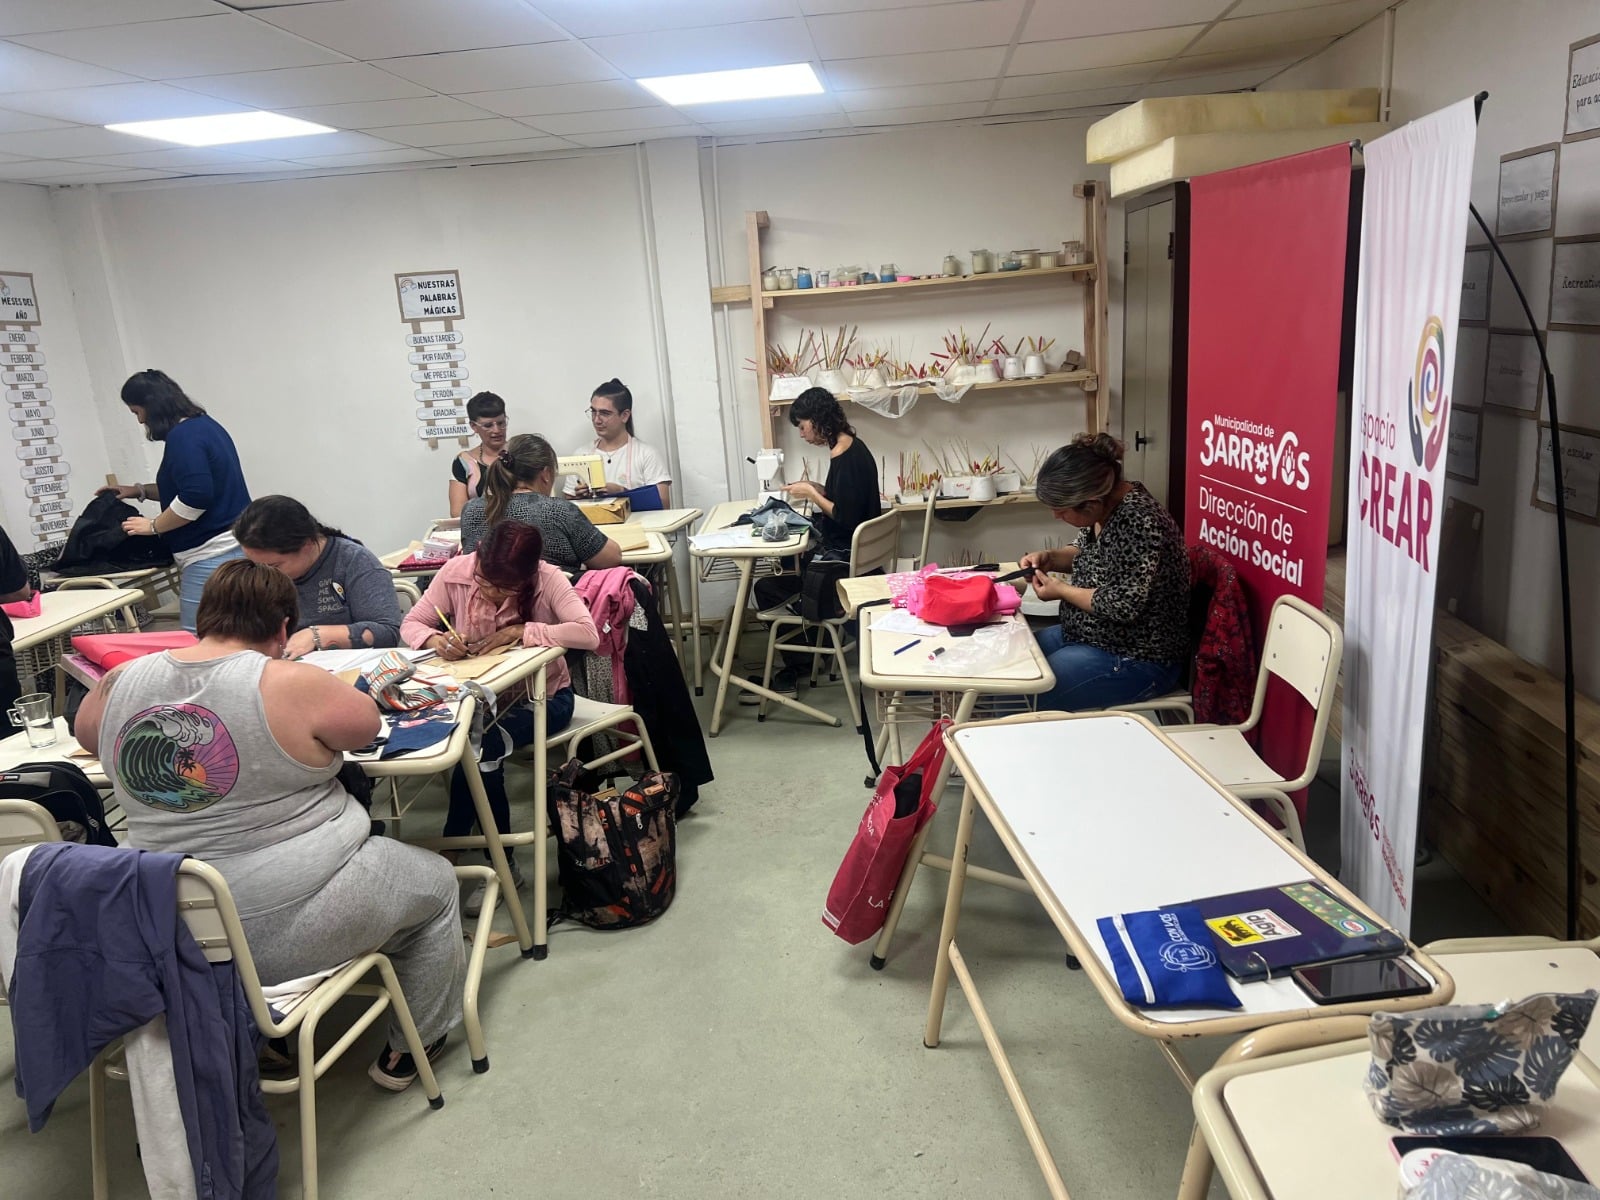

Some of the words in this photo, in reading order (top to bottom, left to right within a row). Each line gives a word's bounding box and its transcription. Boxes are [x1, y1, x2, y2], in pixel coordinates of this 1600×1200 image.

[1577, 96, 1592, 112] para
[417, 280, 455, 290] NUESTRAS
[1, 297, 22, 306] MESES
[23, 298, 34, 307] DEL
[420, 293, 457, 303] PALABRAS
[15, 310, 27, 320] AÑO
[423, 305, 457, 315] MÁGICAS
[8, 333, 26, 343] ENERO
[413, 336, 434, 344] BUENAS
[435, 333, 456, 343] TARDES
[10, 353, 34, 363] FEBRERO
[422, 353, 433, 361] POR
[434, 351, 452, 360] FAVOR
[15, 373, 34, 382] MARZO
[424, 372, 432, 380] ME
[433, 370, 457, 379] PRESTAS
[22, 391, 38, 400] ABRIL
[432, 389, 454, 398] PERDÓN
[24, 409, 41, 418] MAYO
[433, 408, 457, 417] GRACIAS
[425, 428, 443, 436] HASTA
[444, 425, 468, 435] MAÑANA
[1214, 414, 1263, 436] Municipalidad
[1264, 424, 1275, 438] de
[30, 427, 45, 437] JUNIO
[35, 446, 47, 456] JULIO
[34, 465, 54, 475] AGOSTO
[32, 482, 63, 495] SEPTIEMBRE
[40, 501, 63, 513] OCTUBRE
[1200, 486, 1267, 535] Dirección
[1271, 513, 1293, 545] de
[40, 518, 69, 531] NOVIEMBRE
[1199, 518, 1249, 561] Acción
[1252, 540, 1304, 587] Social
[1246, 915, 1282, 935] Agip
